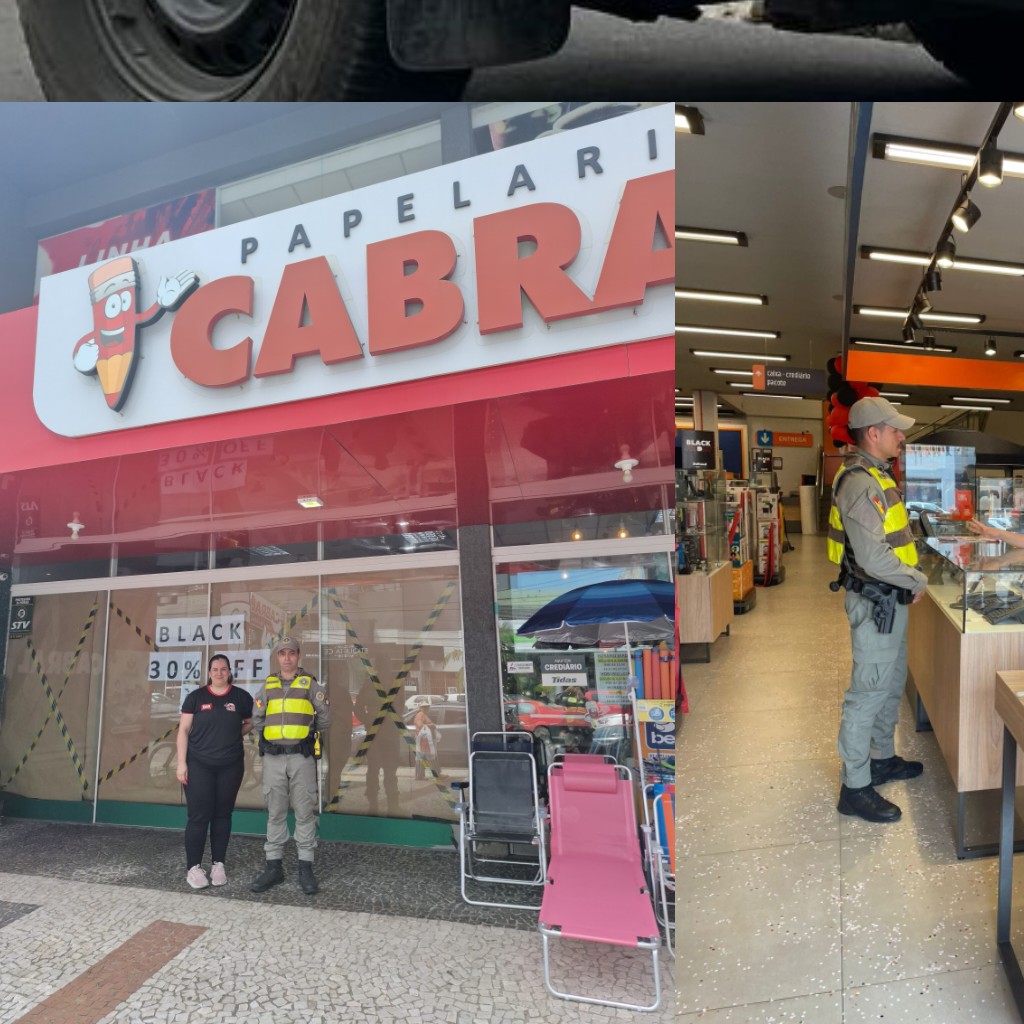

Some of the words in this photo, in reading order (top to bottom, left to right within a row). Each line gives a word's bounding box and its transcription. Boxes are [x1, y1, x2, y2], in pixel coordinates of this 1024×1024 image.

[241, 128, 660, 264] PAPELARI
[170, 170, 675, 391] CABRA
[686, 439, 711, 447] BLACK
[778, 435, 807, 443] ENTREGA
[10, 620, 31, 630] STV
[158, 621, 242, 643] BLACK
[148, 659, 202, 679] 30%
[231, 658, 264, 678] FF
[544, 663, 583, 671] CREDIÁRIO
